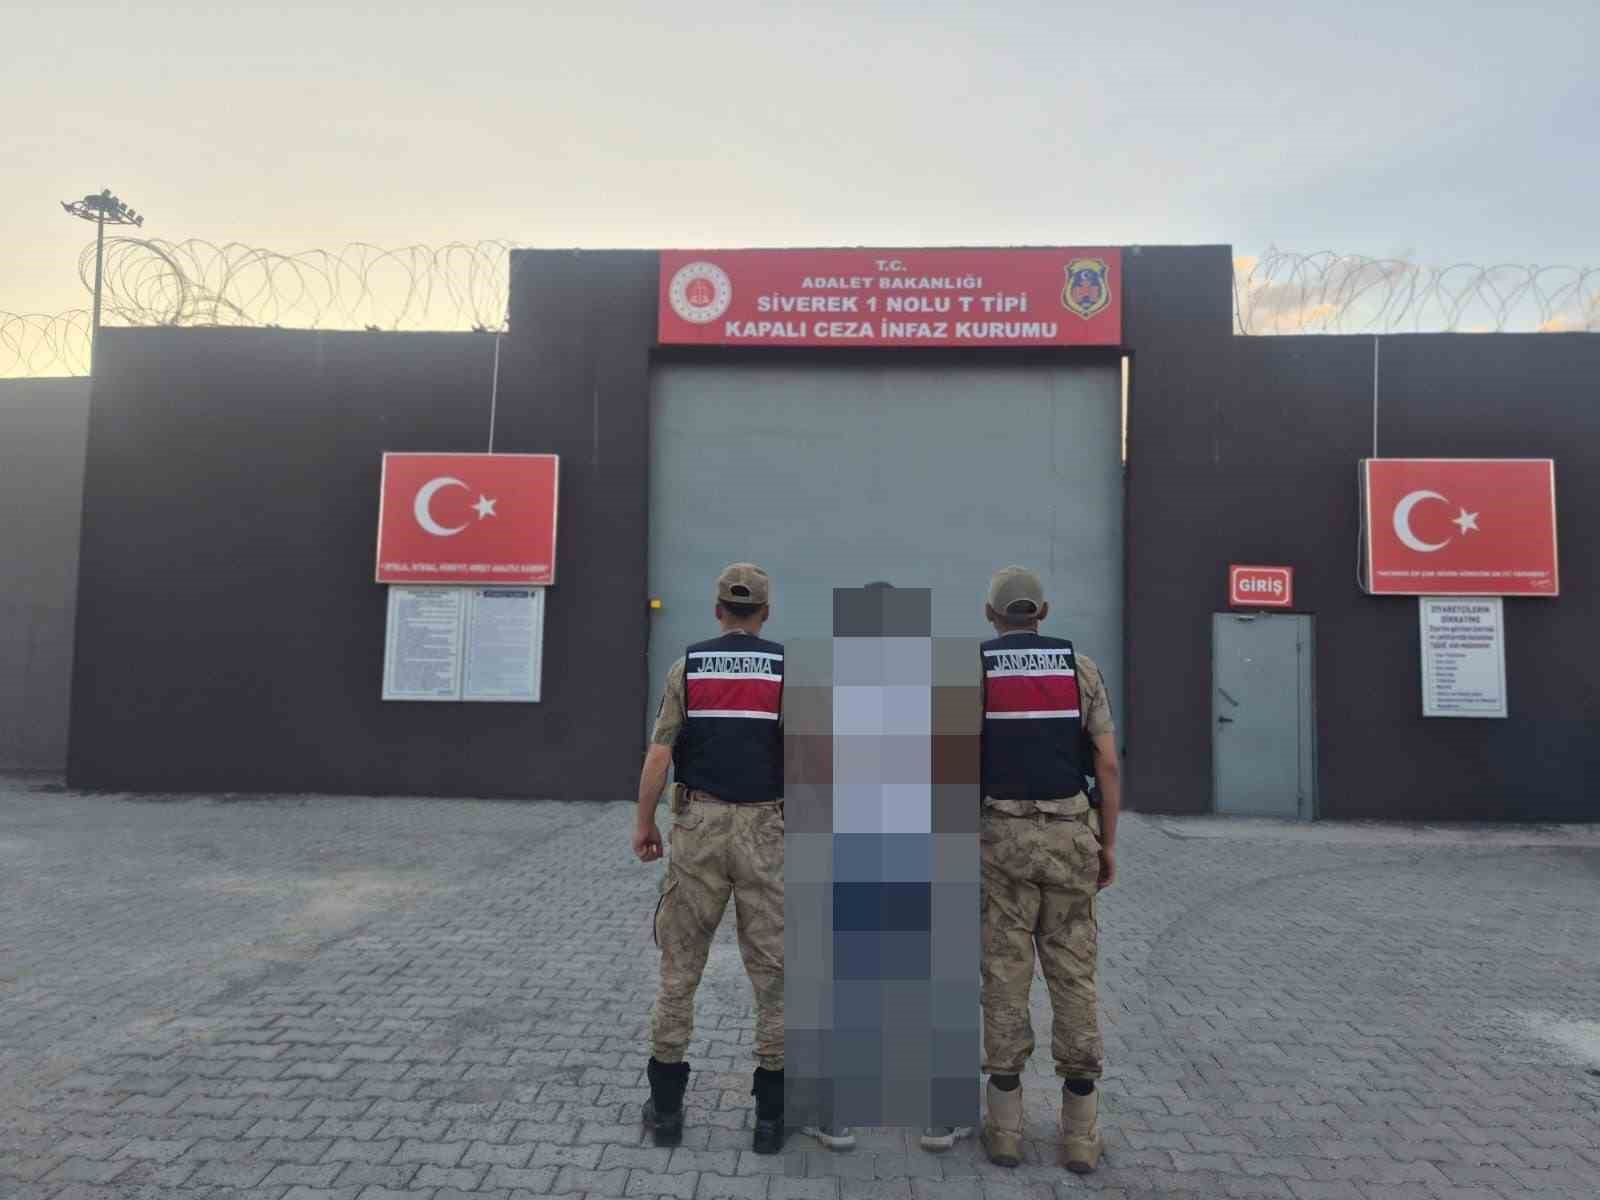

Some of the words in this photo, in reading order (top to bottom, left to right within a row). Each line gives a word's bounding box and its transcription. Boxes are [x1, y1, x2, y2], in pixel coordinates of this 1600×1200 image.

[876, 260, 907, 271] T.C.
[802, 277, 873, 289] ADALET
[879, 273, 983, 289] BAKANLIĞI
[757, 292, 859, 312] SİVEREK
[866, 297, 877, 312] 1
[886, 297, 950, 312] NOLU
[959, 297, 973, 312] T
[980, 292, 1028, 312] TİPİ
[725, 321, 807, 337] KAPALI
[813, 322, 874, 337] CEZA
[881, 317, 948, 338] İNFAZ
[955, 322, 1058, 338] KURUMU
[1239, 576, 1283, 597] GİRİŞ
[697, 656, 772, 673] JANDARMA
[993, 655, 1069, 671] JANDARMA
